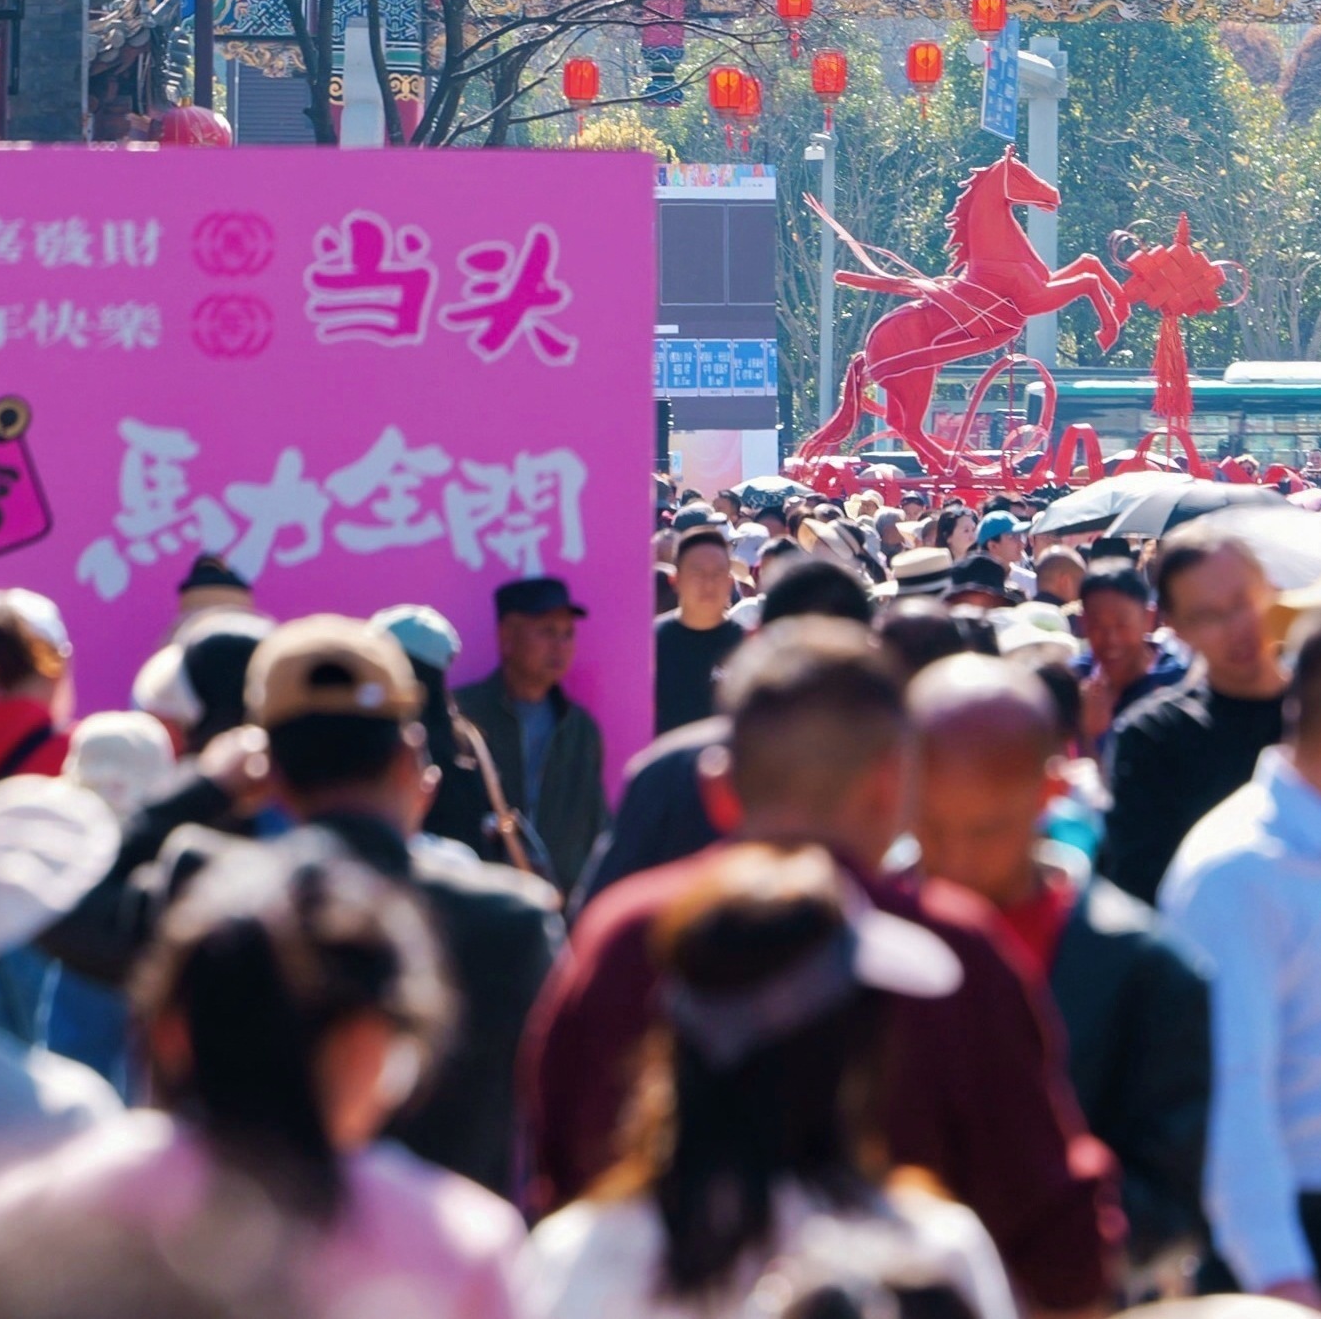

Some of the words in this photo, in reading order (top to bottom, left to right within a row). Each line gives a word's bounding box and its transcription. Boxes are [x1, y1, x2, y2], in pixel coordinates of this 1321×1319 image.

[306, 212, 574, 363] 当头
[76, 417, 588, 602] 馬力全開
